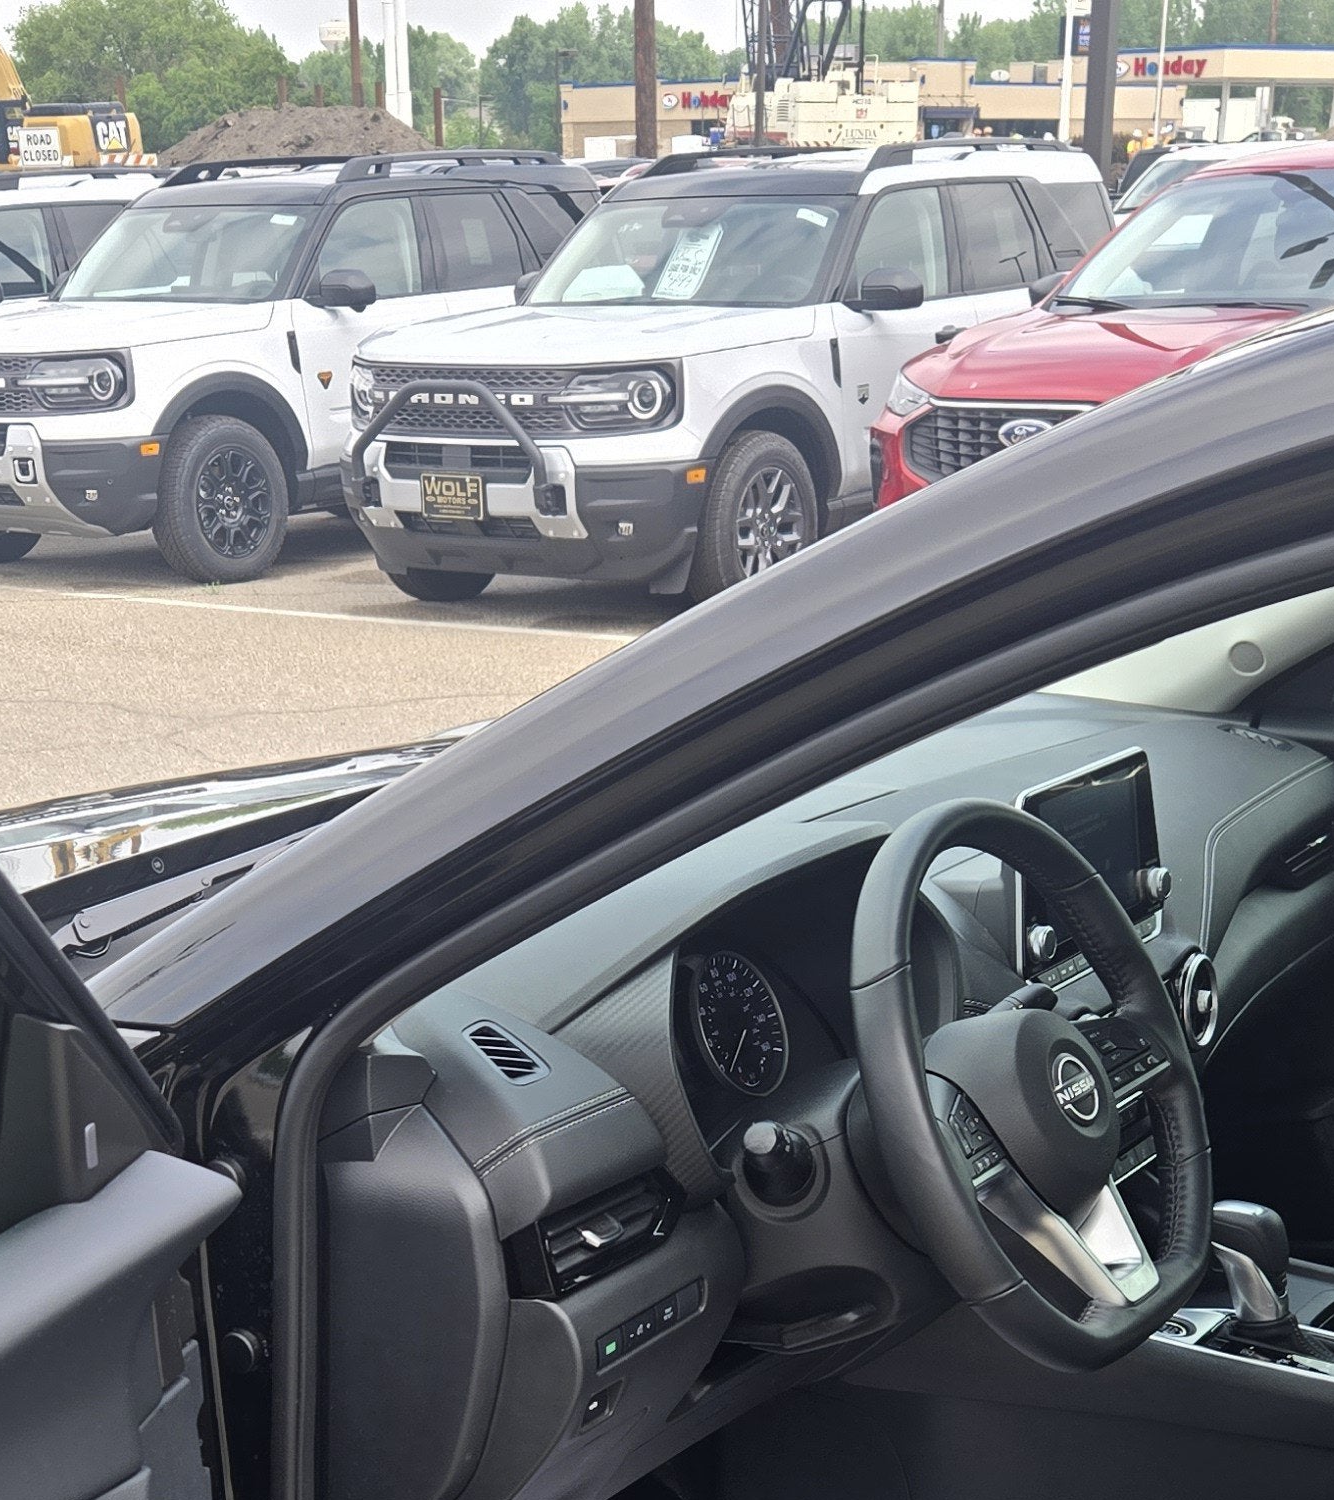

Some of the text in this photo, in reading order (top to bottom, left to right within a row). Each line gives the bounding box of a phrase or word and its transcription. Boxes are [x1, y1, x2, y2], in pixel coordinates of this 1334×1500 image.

[1134, 56, 1207, 78] Hoiday
[26, 133, 52, 146] ROAD
[96, 121, 128, 151] CAT
[23, 149, 59, 162] CLOSED
[424, 480, 478, 497] WOLF
[436, 495, 467, 505] MOTORS
